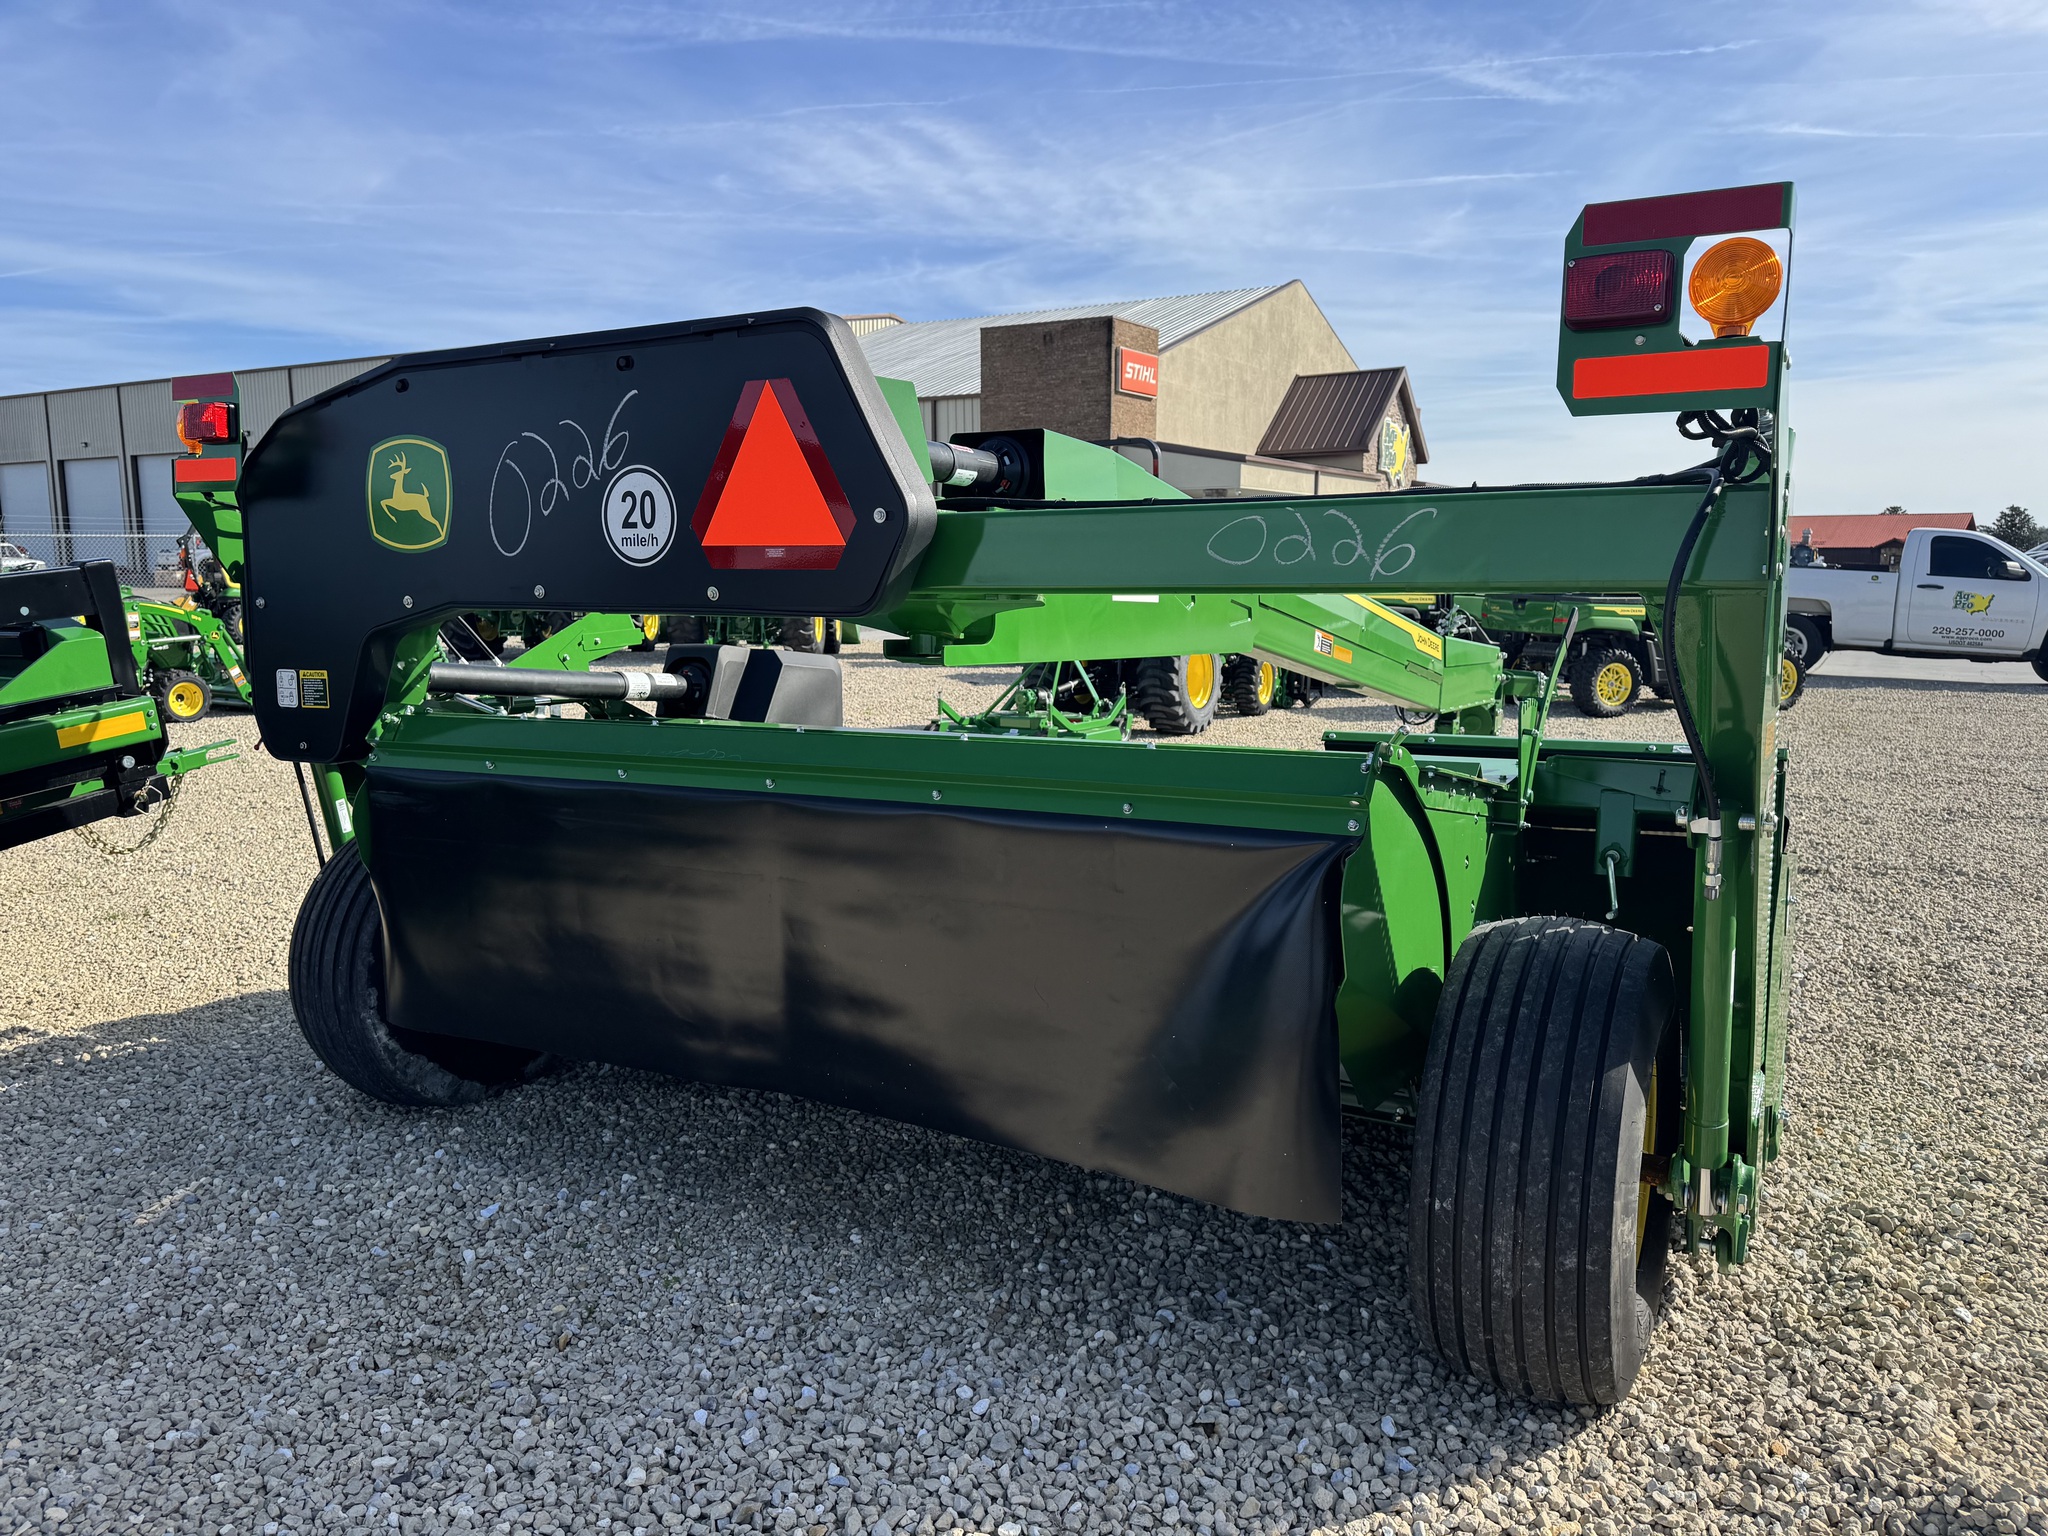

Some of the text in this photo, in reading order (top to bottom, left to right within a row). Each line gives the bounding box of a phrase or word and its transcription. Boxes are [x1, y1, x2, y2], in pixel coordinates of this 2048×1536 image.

[1125, 362, 1156, 384] STIHL
[1383, 445, 1397, 469] Pro
[490, 390, 638, 556] 0226
[621, 490, 656, 529] 20
[621, 533, 659, 547] mile/h
[1207, 507, 1437, 581] 0226
[1953, 600, 1974, 609] Pro
[1932, 626, 2005, 638] 229-257-0000
